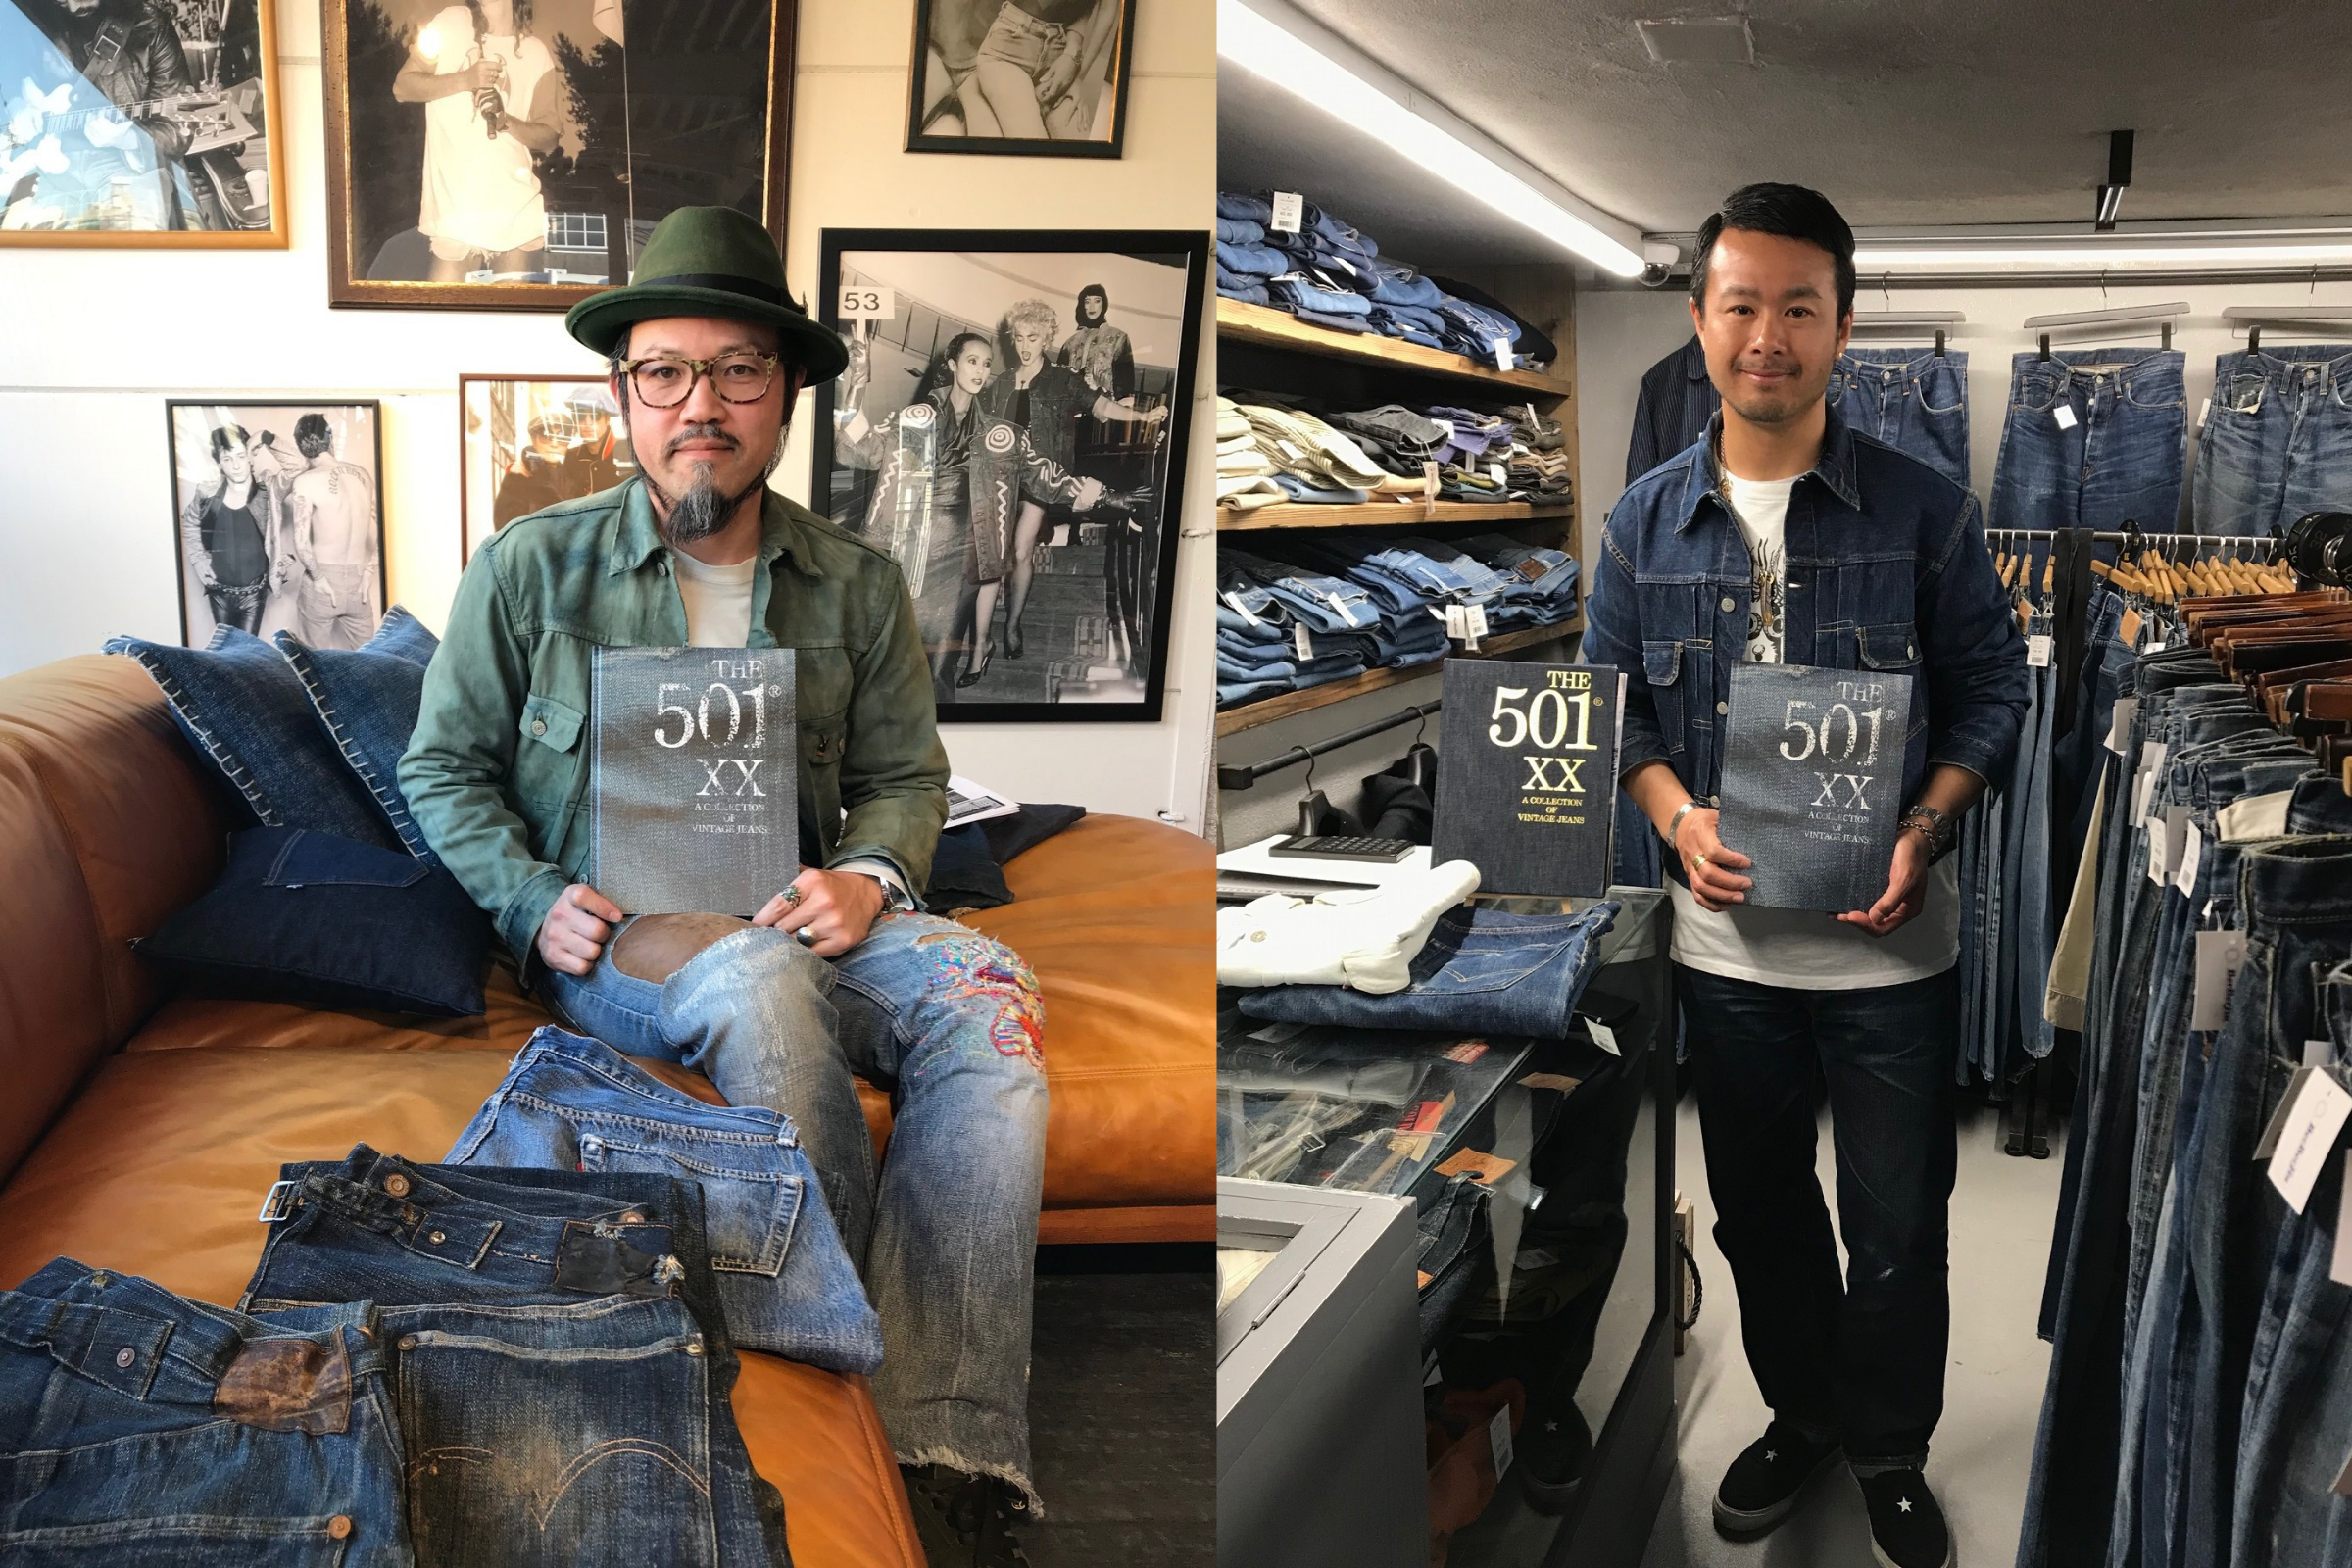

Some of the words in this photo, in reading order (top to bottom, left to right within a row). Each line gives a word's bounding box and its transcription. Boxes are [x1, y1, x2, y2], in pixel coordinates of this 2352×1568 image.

[844, 292, 880, 311] 53
[711, 660, 763, 679] THE
[1546, 670, 1591, 690] THE
[1837, 681, 1883, 703] THE
[695, 759, 766, 797] XX
[1521, 756, 1586, 793] XX
[1810, 771, 1874, 810] XX
[694, 803, 702, 811] A
[1521, 796, 1529, 805] A
[1530, 796, 1583, 807] COLLECTION
[1545, 806, 1557, 814] OF
[722, 814, 735, 823] OF
[1517, 813, 1555, 823] VINTAGE
[1556, 814, 1585, 824] JEANS
[692, 824, 735, 834] VINTAGE
[737, 824, 767, 834] JEANS
[1832, 823, 1842, 832] OF
[1804, 831, 1841, 842] VINTAGE
[1841, 832, 1870, 844] JEANS
